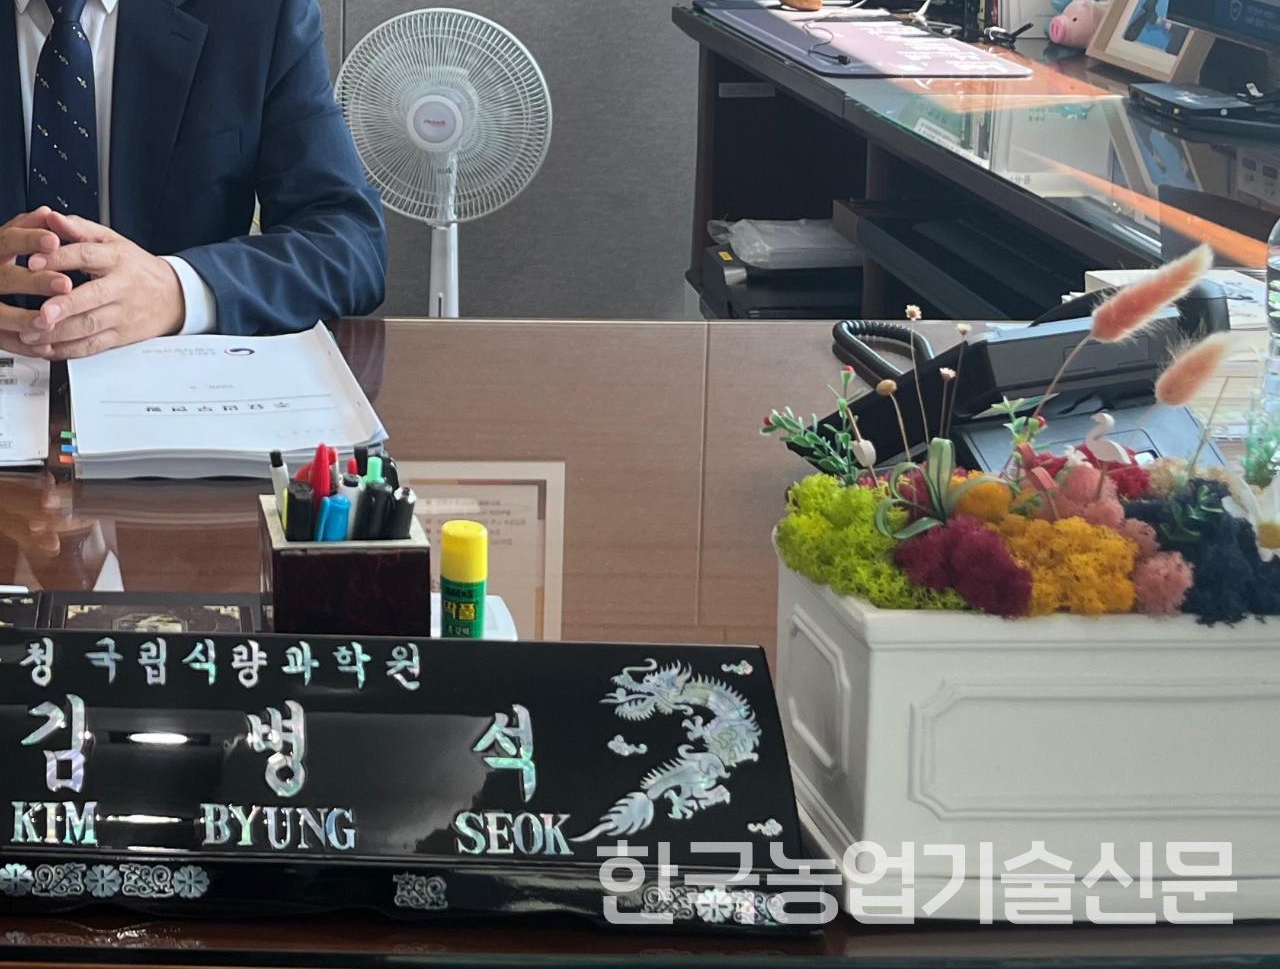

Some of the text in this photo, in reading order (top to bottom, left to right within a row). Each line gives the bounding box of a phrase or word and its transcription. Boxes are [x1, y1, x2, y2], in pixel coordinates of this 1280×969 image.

[11, 801, 99, 847] KIM
[200, 803, 357, 852] BYUNG
[454, 811, 574, 857] SEOK
